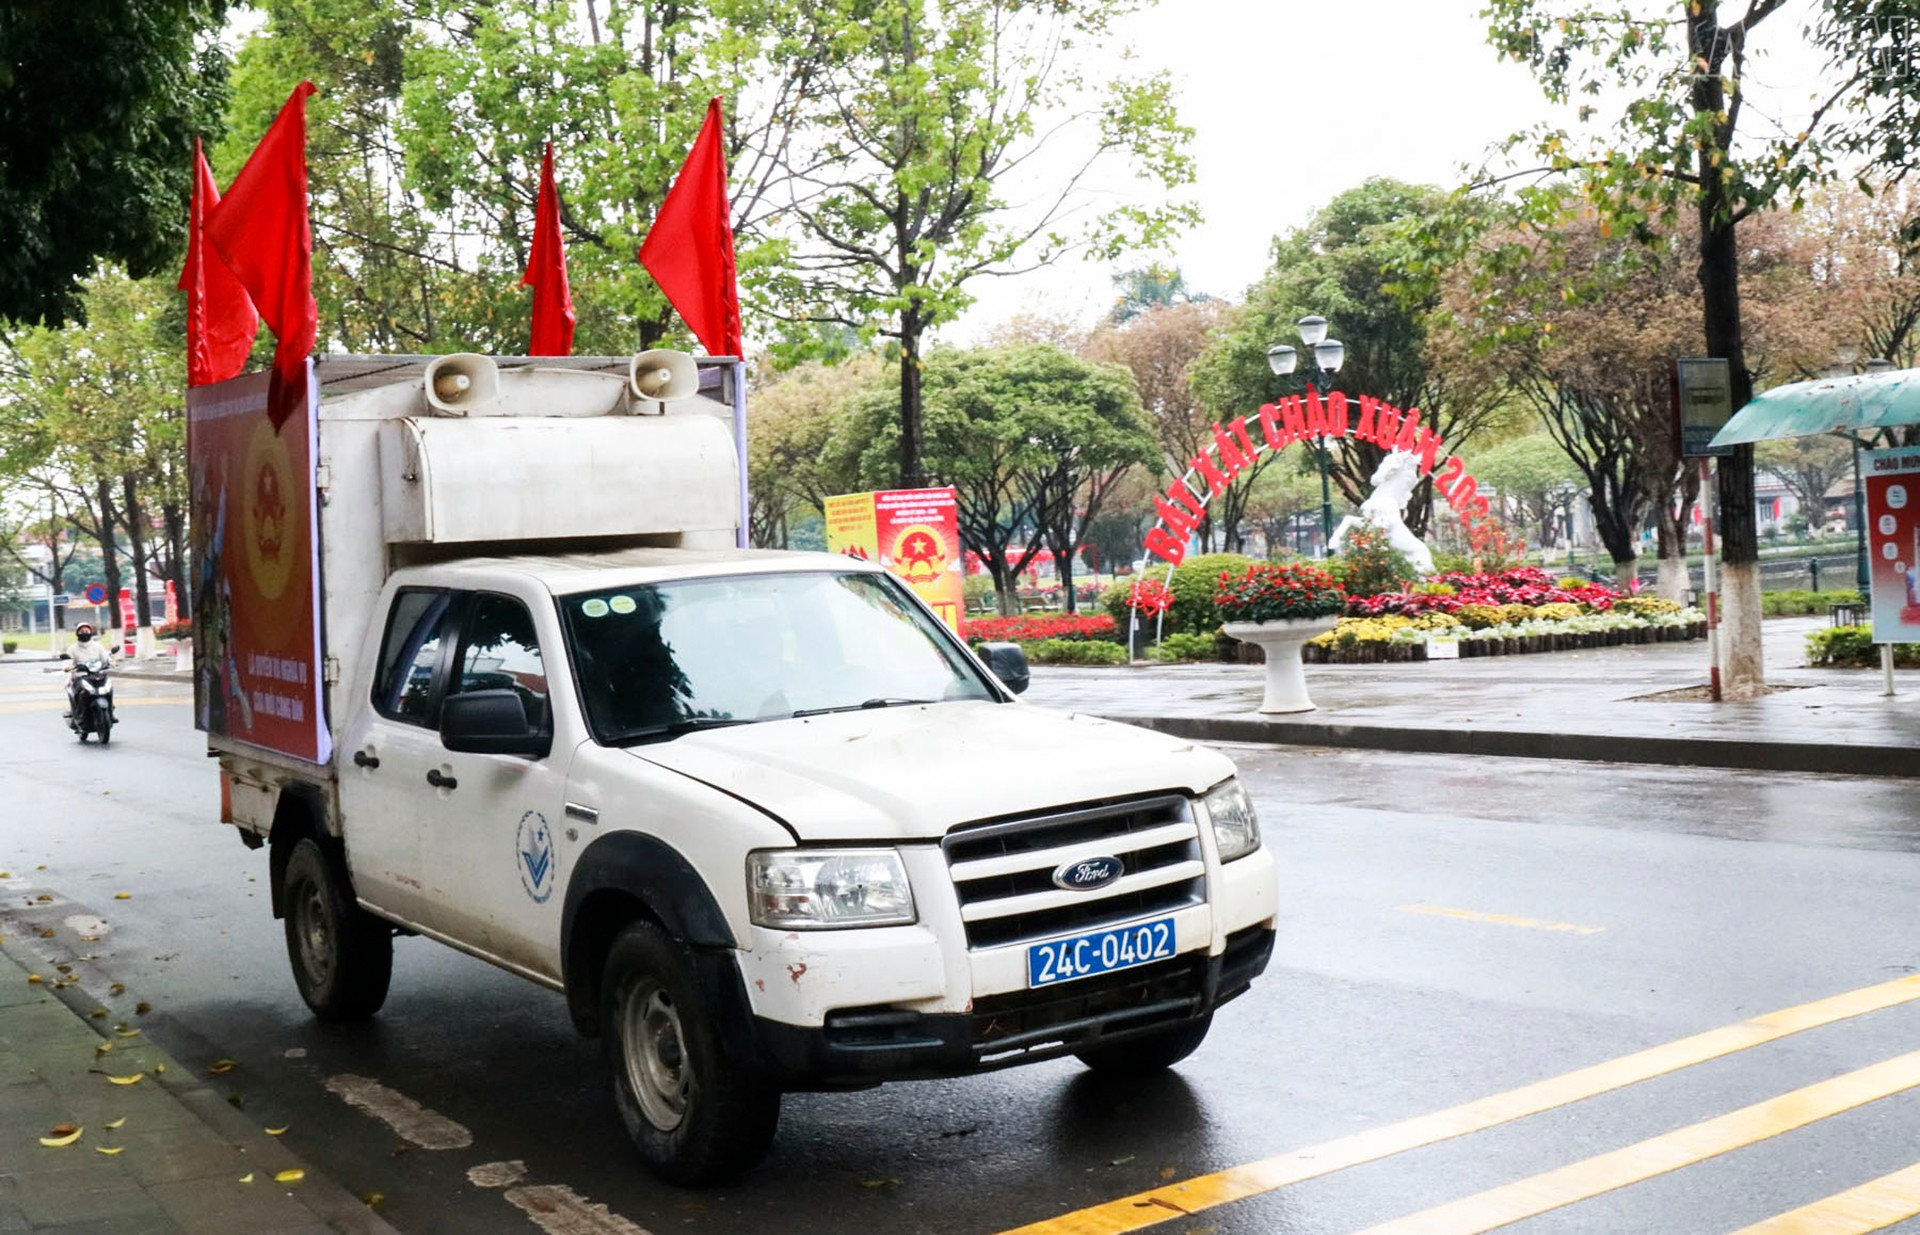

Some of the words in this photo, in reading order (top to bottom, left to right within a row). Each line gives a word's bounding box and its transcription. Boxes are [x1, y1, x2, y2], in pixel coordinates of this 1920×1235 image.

[1144, 477, 1206, 567] BÁT
[1189, 415, 1259, 498] XÁT
[1259, 382, 1348, 450] CHÀO
[1354, 394, 1442, 475] XUÂN
[1433, 456, 1492, 551] 202
[1075, 861, 1110, 883] Ford
[1038, 922, 1170, 983] 24C-0402
